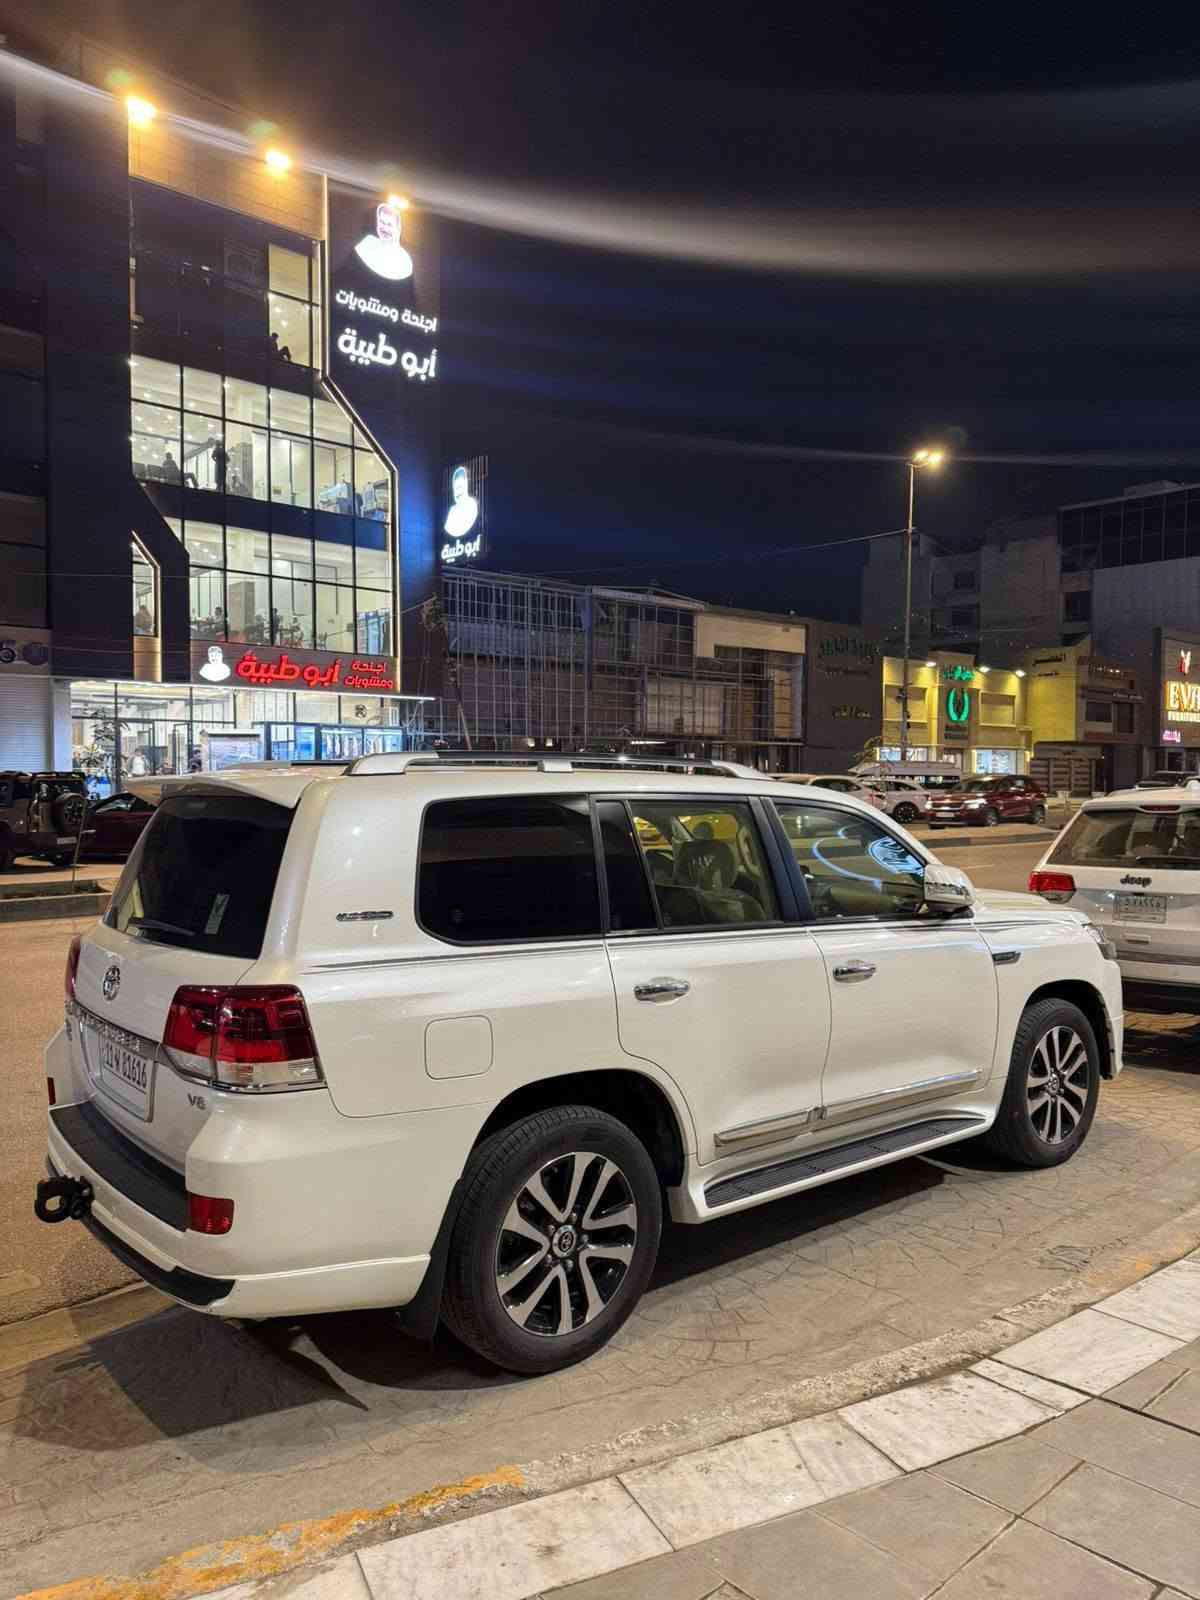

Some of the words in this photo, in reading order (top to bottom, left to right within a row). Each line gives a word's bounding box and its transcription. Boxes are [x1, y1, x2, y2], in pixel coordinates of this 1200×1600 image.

[335, 289, 399, 323] ومشويات
[401, 348, 438, 381] أبو
[303, 656, 342, 688] أبو
